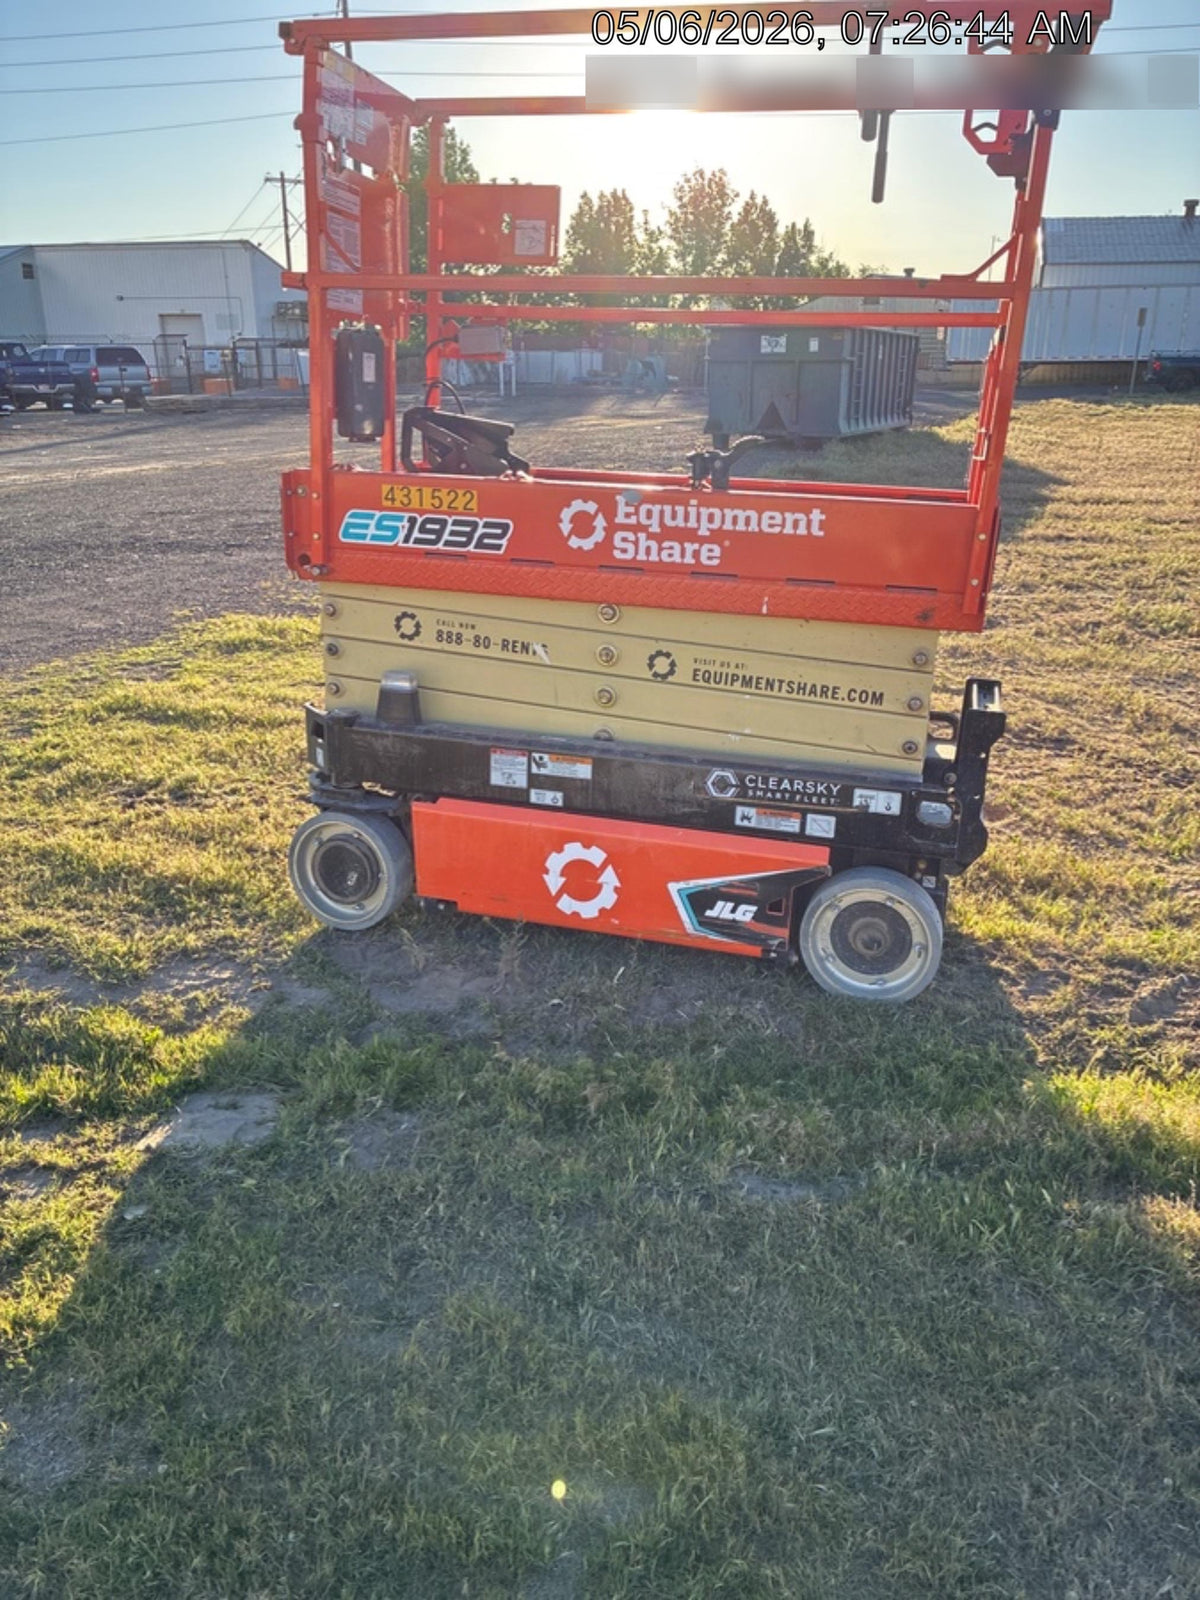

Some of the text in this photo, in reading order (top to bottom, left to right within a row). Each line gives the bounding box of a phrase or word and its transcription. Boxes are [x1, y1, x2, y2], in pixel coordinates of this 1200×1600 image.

[384, 486, 475, 510] 431522
[614, 495, 826, 537] Equipment
[341, 511, 511, 553] ES1932
[612, 532, 721, 566] Share
[436, 619, 476, 630] CALL NOW
[693, 657, 717, 667] VISIT
[720, 660, 731, 668] US
[692, 668, 885, 706] EQUIPMENTSHARE.COM
[745, 775, 842, 796] CLEARSKY
[747, 790, 837, 806] SMART FLEET
[704, 901, 758, 922] JLG
